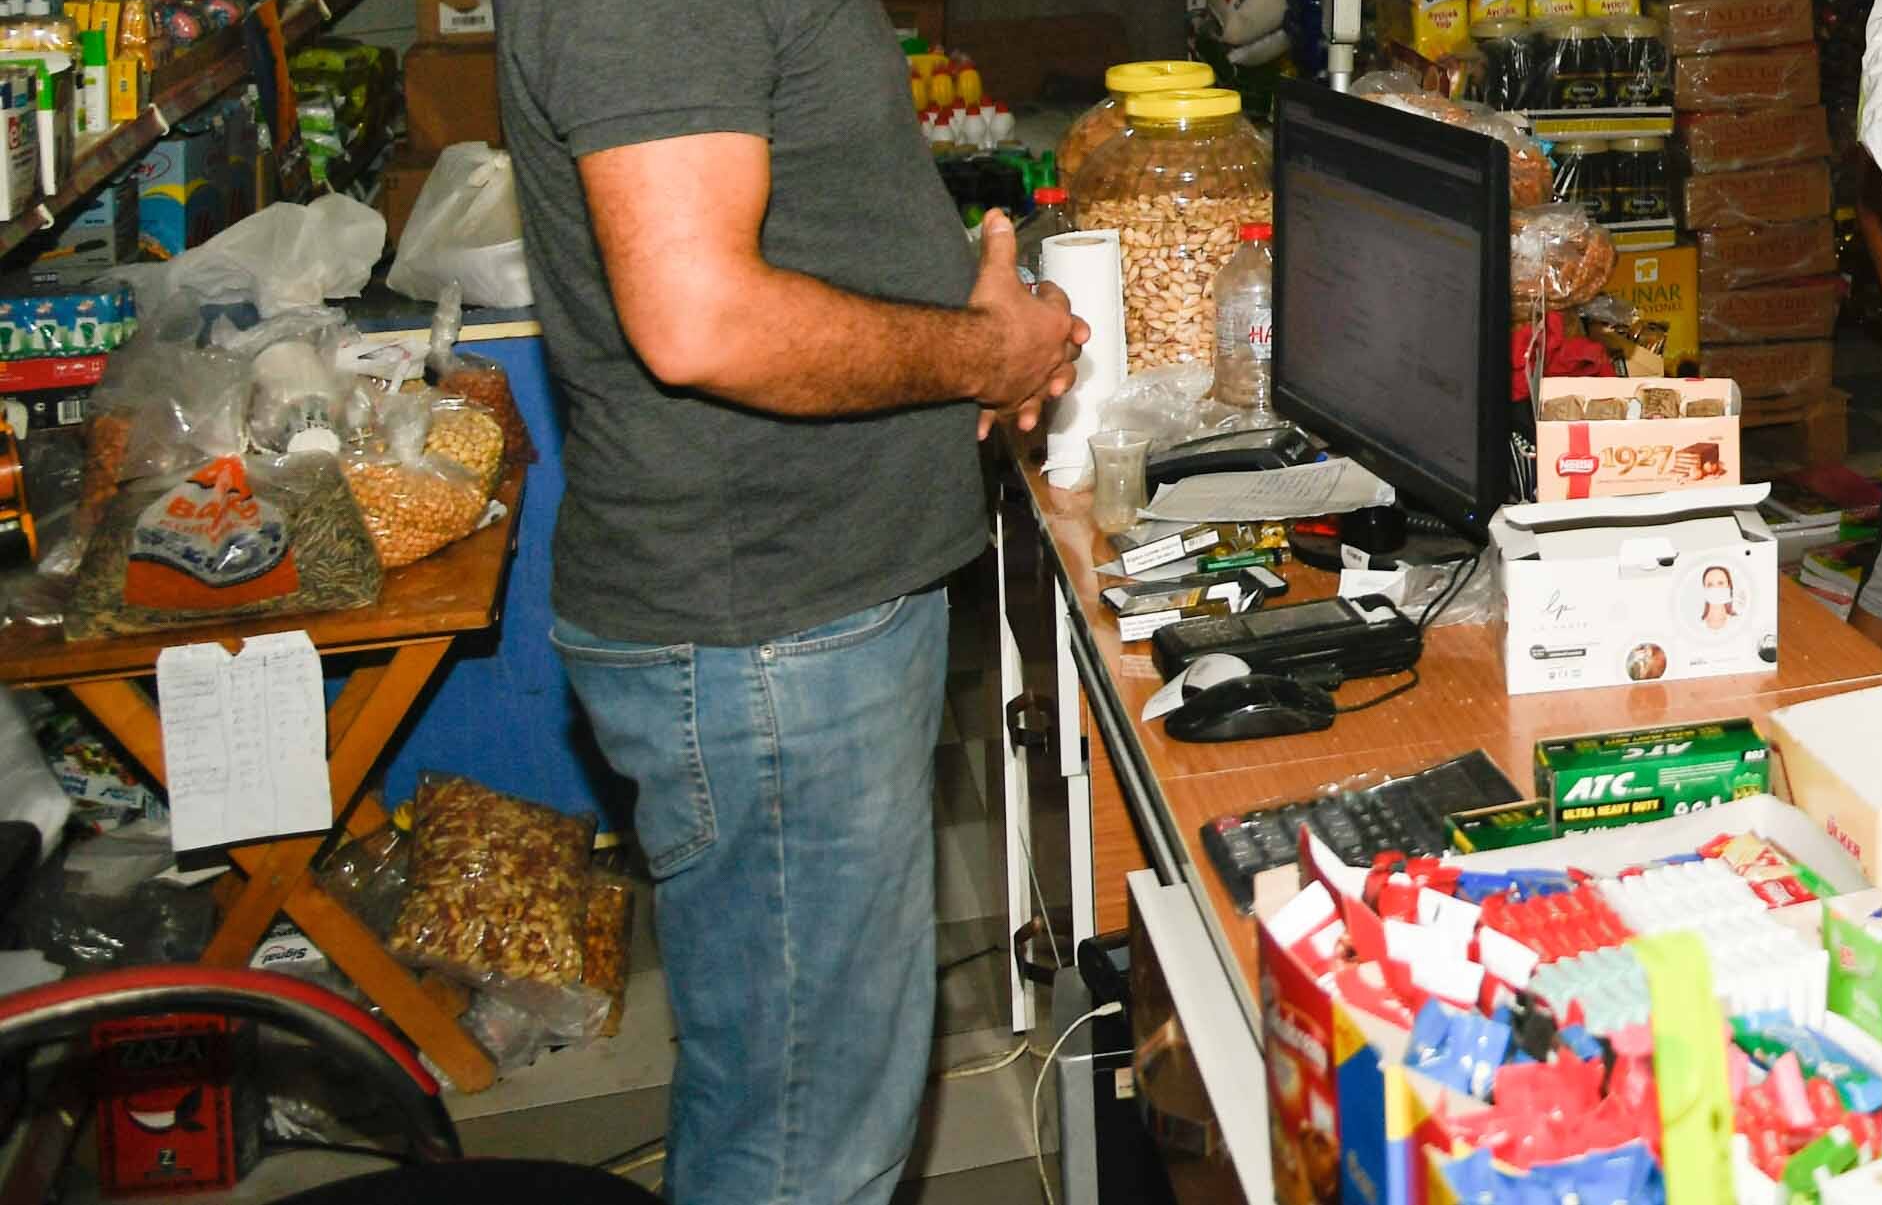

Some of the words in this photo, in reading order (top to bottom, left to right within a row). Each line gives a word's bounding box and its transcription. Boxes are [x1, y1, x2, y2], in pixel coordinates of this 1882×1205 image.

[1249, 325, 1272, 344] HA
[1600, 444, 1674, 476] 1927
[1620, 740, 1695, 761] ATC
[1562, 770, 1636, 802] ATC
[1597, 802, 1630, 816] HEAVY
[1631, 798, 1660, 813] DUTY
[1825, 817, 1862, 861] ÜLKER
[262, 947, 308, 964] Signal
